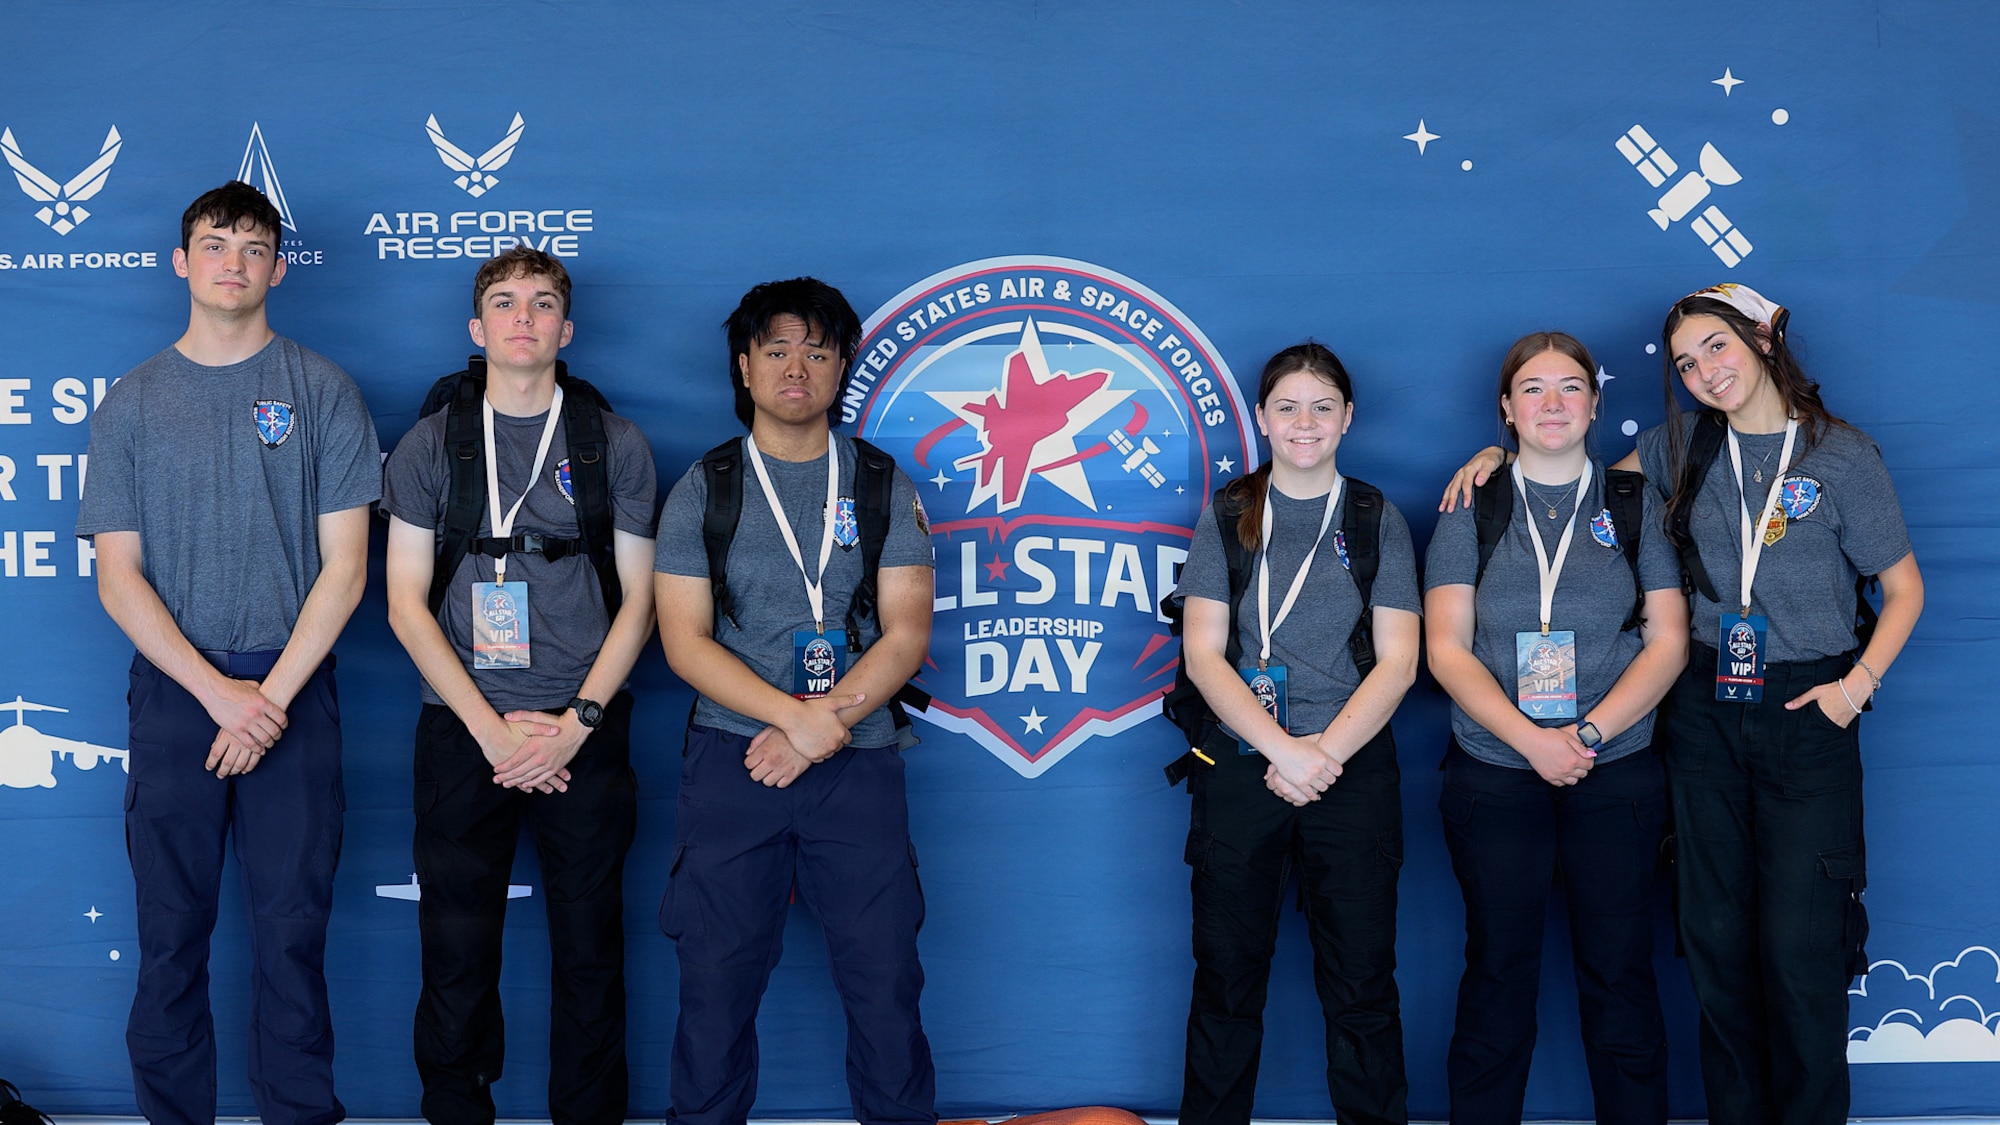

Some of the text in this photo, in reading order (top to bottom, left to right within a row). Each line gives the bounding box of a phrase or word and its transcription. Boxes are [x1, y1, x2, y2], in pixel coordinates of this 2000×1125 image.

[364, 209, 594, 235] AIR FORCE
[21, 253, 64, 269] AIR
[70, 252, 158, 268] FORCE
[841, 277, 1226, 427] UNITED STATES AIR & SPACE FORCES
[933, 540, 998, 612] LL
[489, 629, 514, 643] VIP
[964, 617, 1104, 641] LEADERSHIP
[965, 638, 1103, 697] DAY
[1730, 661, 1752, 676] VIP
[807, 678, 831, 692] VIP
[1533, 679, 1559, 692] VIP
